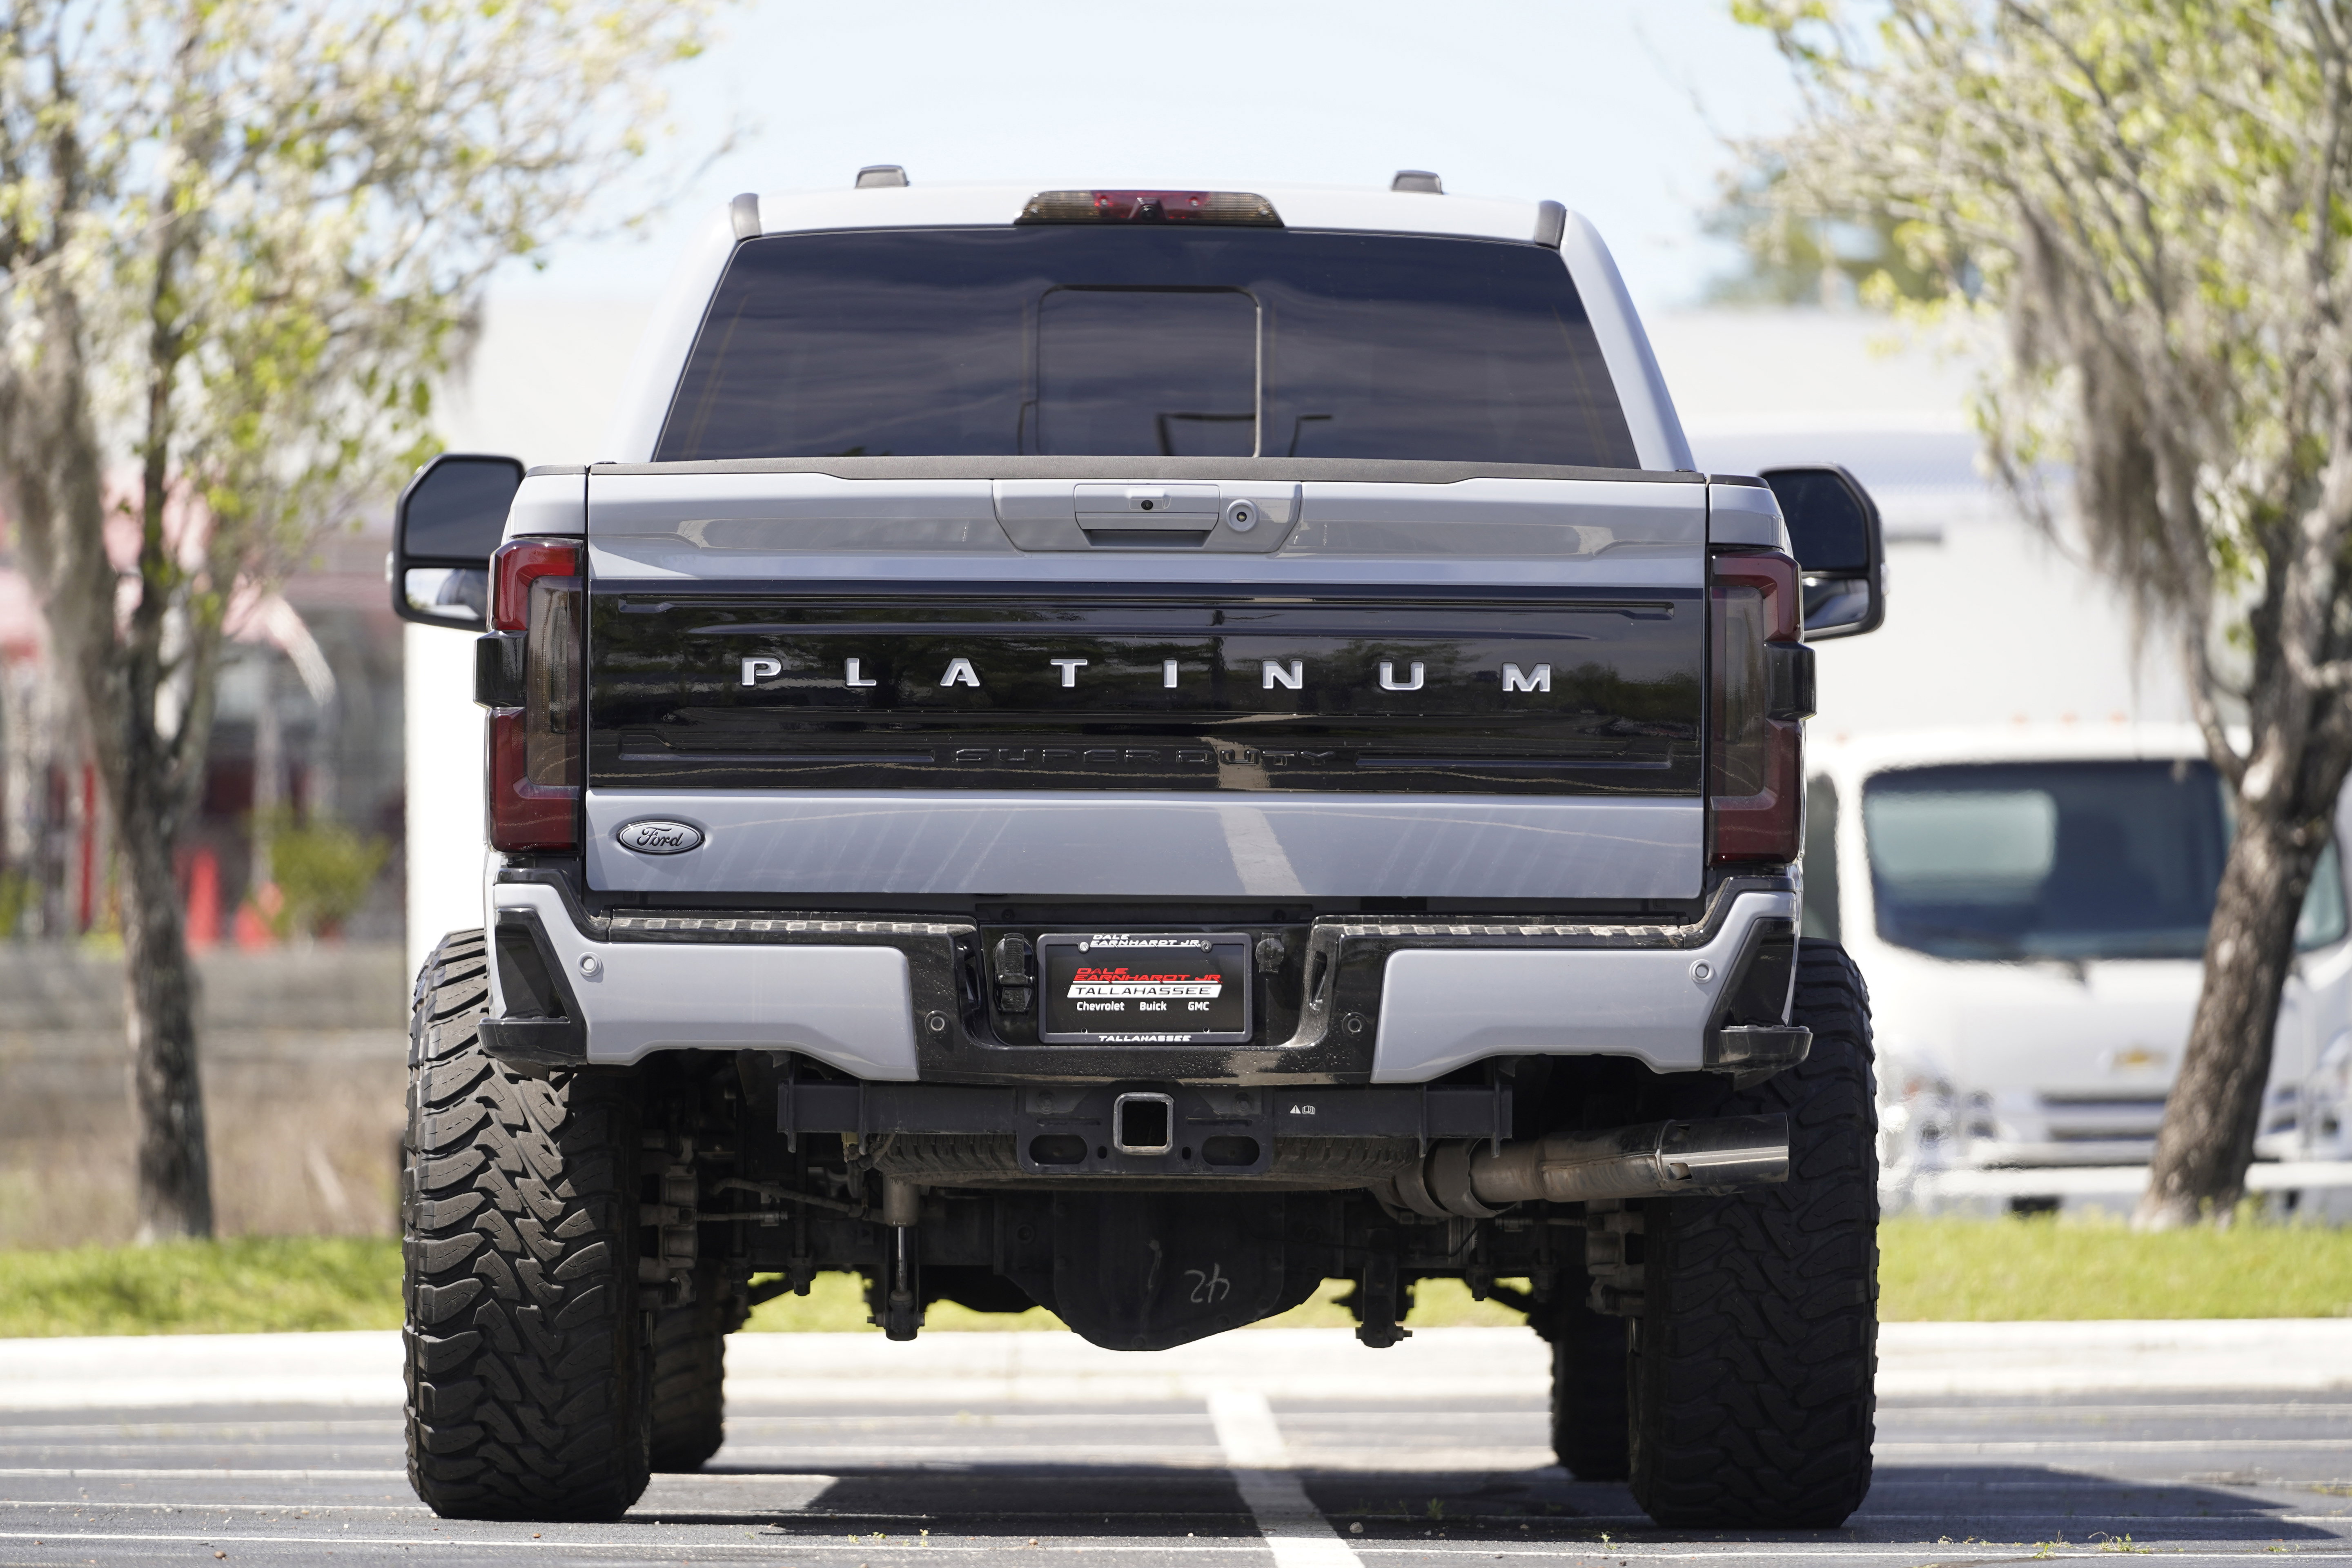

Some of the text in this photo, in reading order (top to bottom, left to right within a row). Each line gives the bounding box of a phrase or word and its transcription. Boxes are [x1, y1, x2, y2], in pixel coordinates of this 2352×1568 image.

[741, 657, 1551, 693] PLATINUM
[954, 748, 1335, 766] SUPER DUTY
[637, 827, 684, 846] Ford
[1074, 974, 1190, 983] EARNHARDT
[1075, 987, 1212, 995] TALLAHASSEE
[1076, 1001, 1210, 1011] Chevrolet Buick GMC
